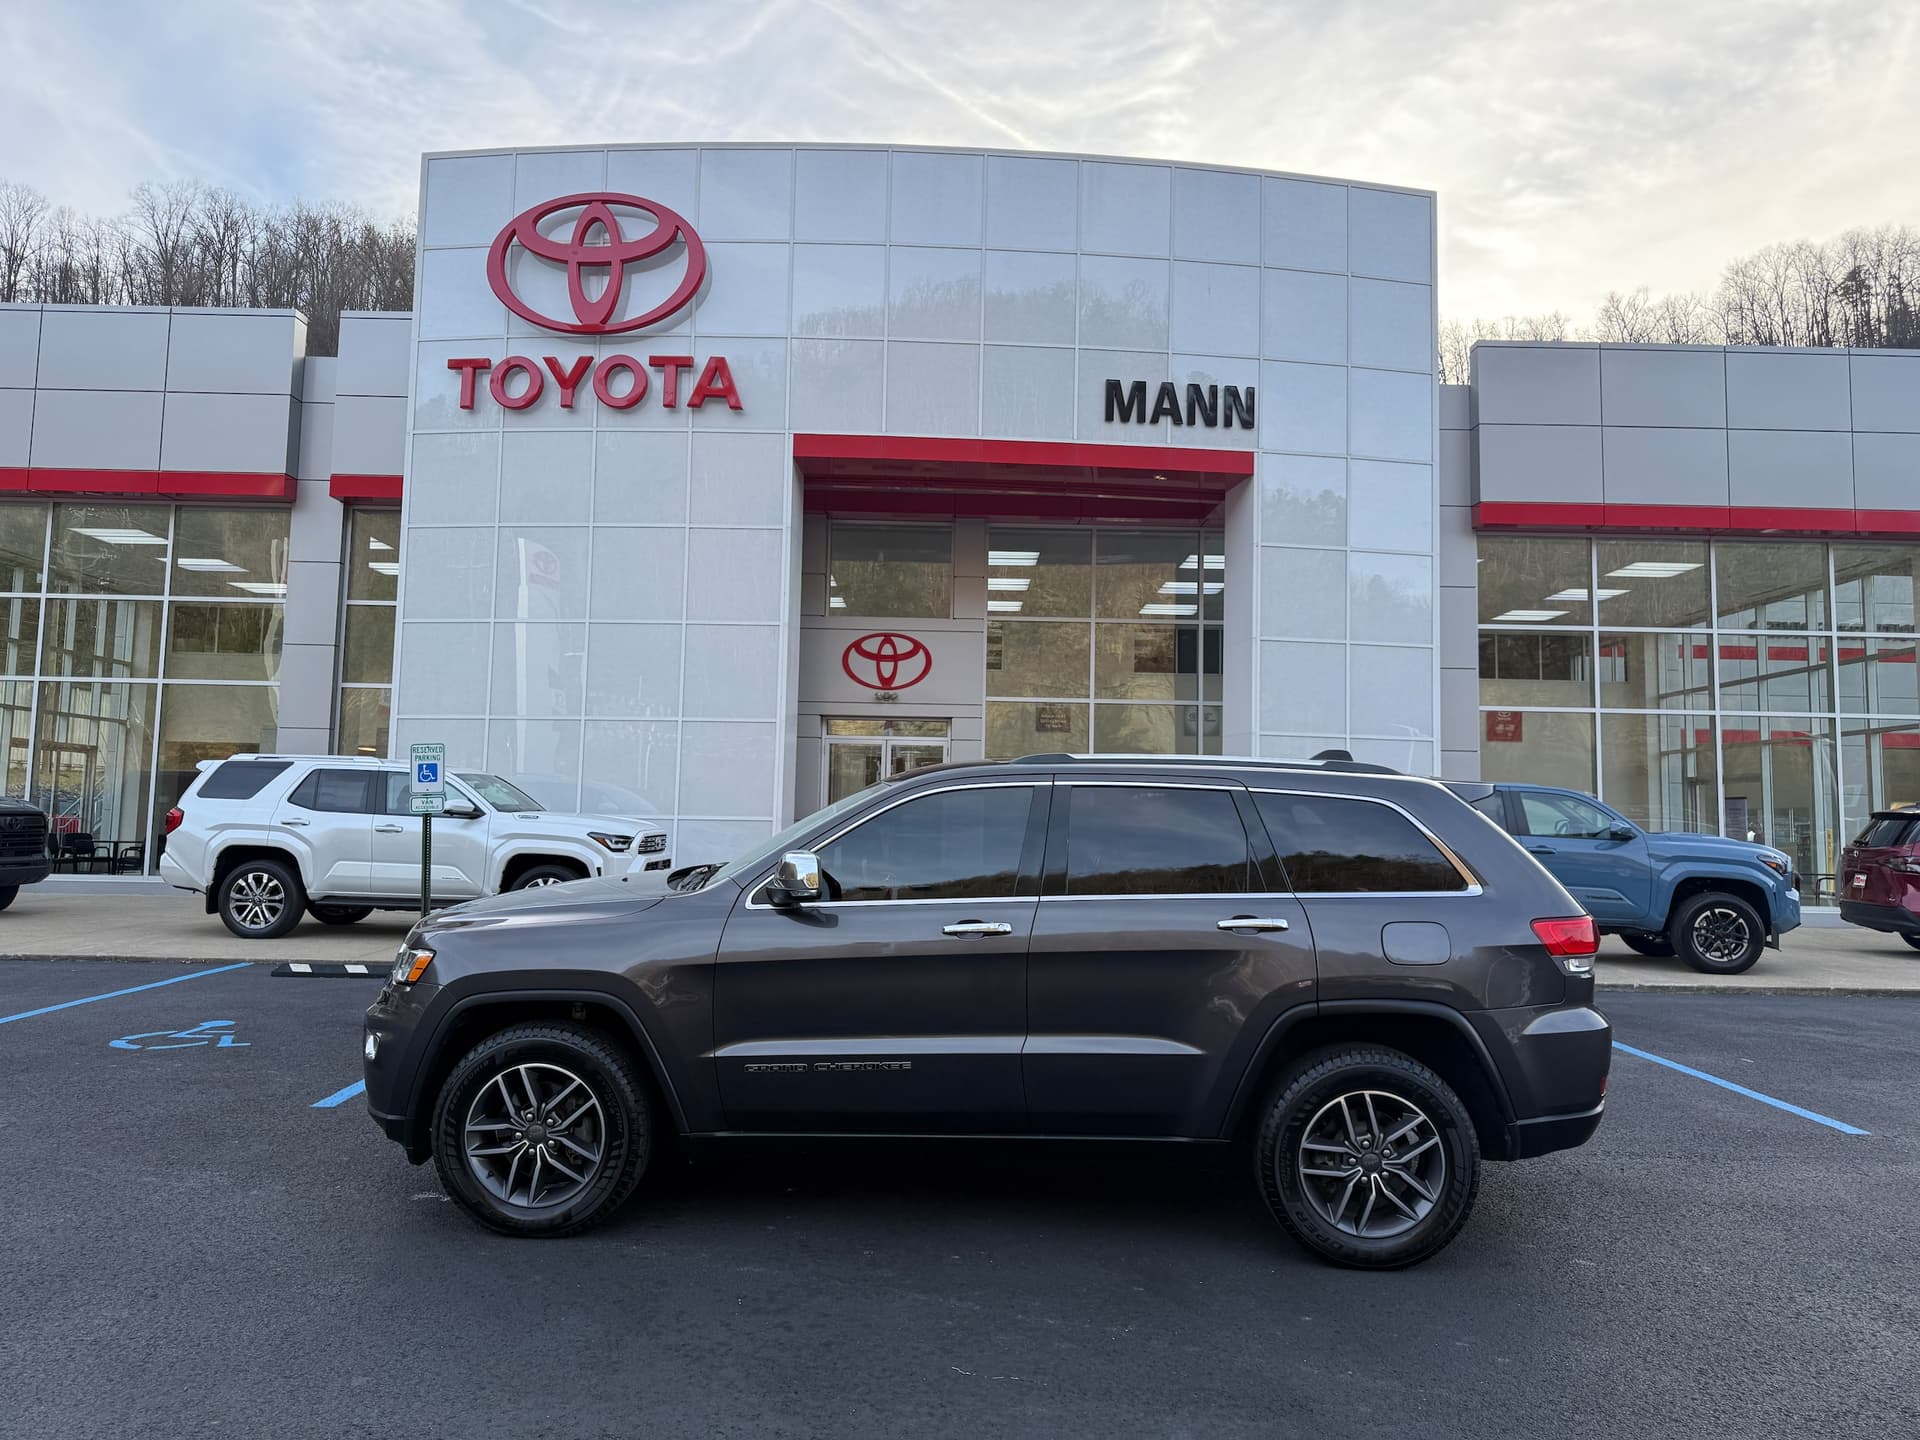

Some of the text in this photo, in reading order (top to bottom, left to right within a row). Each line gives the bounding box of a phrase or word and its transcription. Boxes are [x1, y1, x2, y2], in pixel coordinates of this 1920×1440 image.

[447, 354, 744, 411] TOYOTA
[1104, 379, 1256, 429] MANN
[744, 1061, 913, 1073] GRAND CHEROKEE
